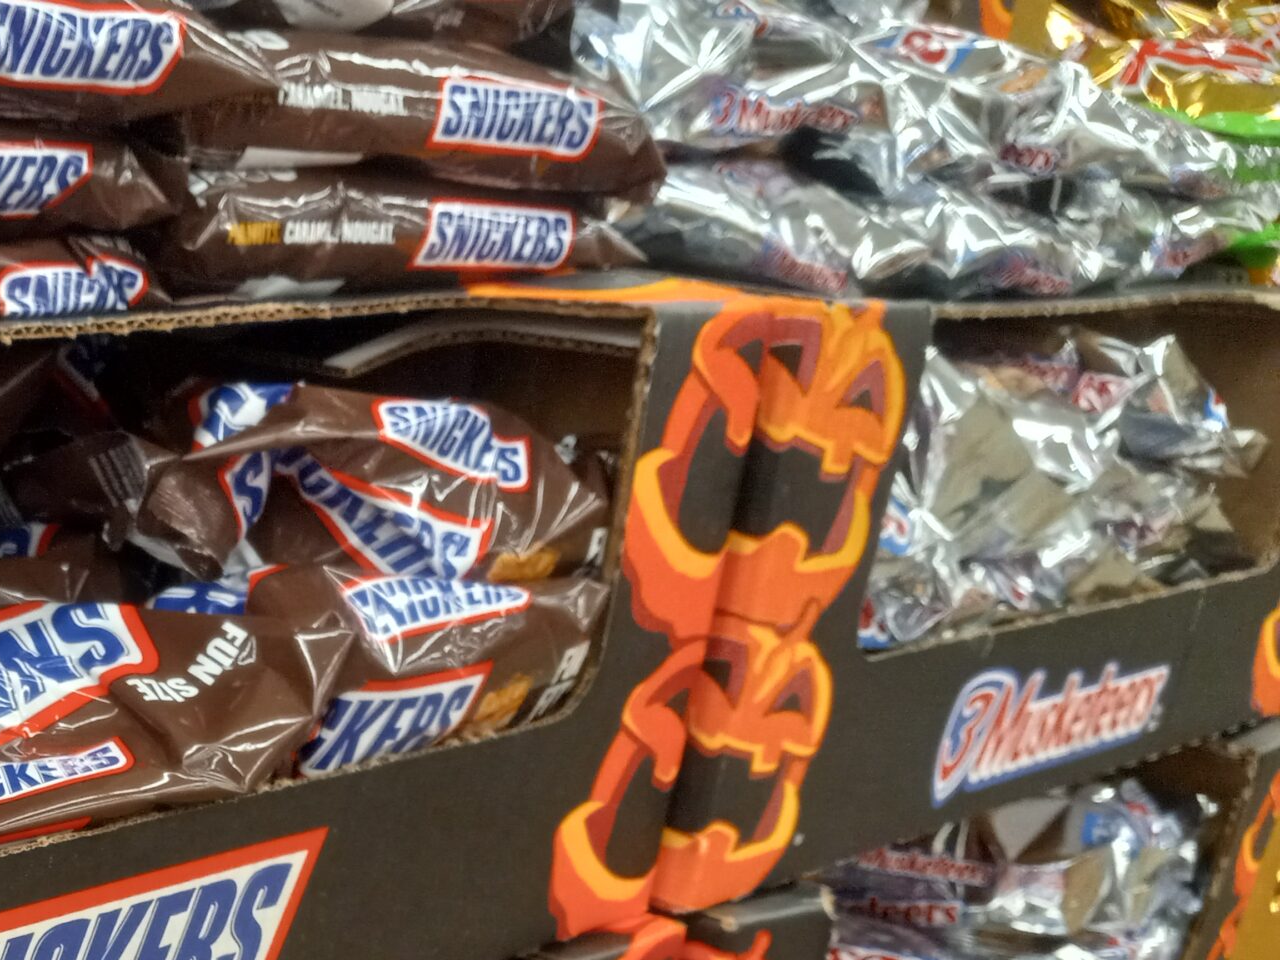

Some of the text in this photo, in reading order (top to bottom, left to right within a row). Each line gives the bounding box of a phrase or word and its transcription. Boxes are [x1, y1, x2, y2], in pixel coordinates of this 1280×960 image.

[441, 85, 593, 151] SNICKERS
[426, 208, 569, 268] SNICKERS
[187, 620, 248, 686] FUN
[939, 686, 998, 783] 3
